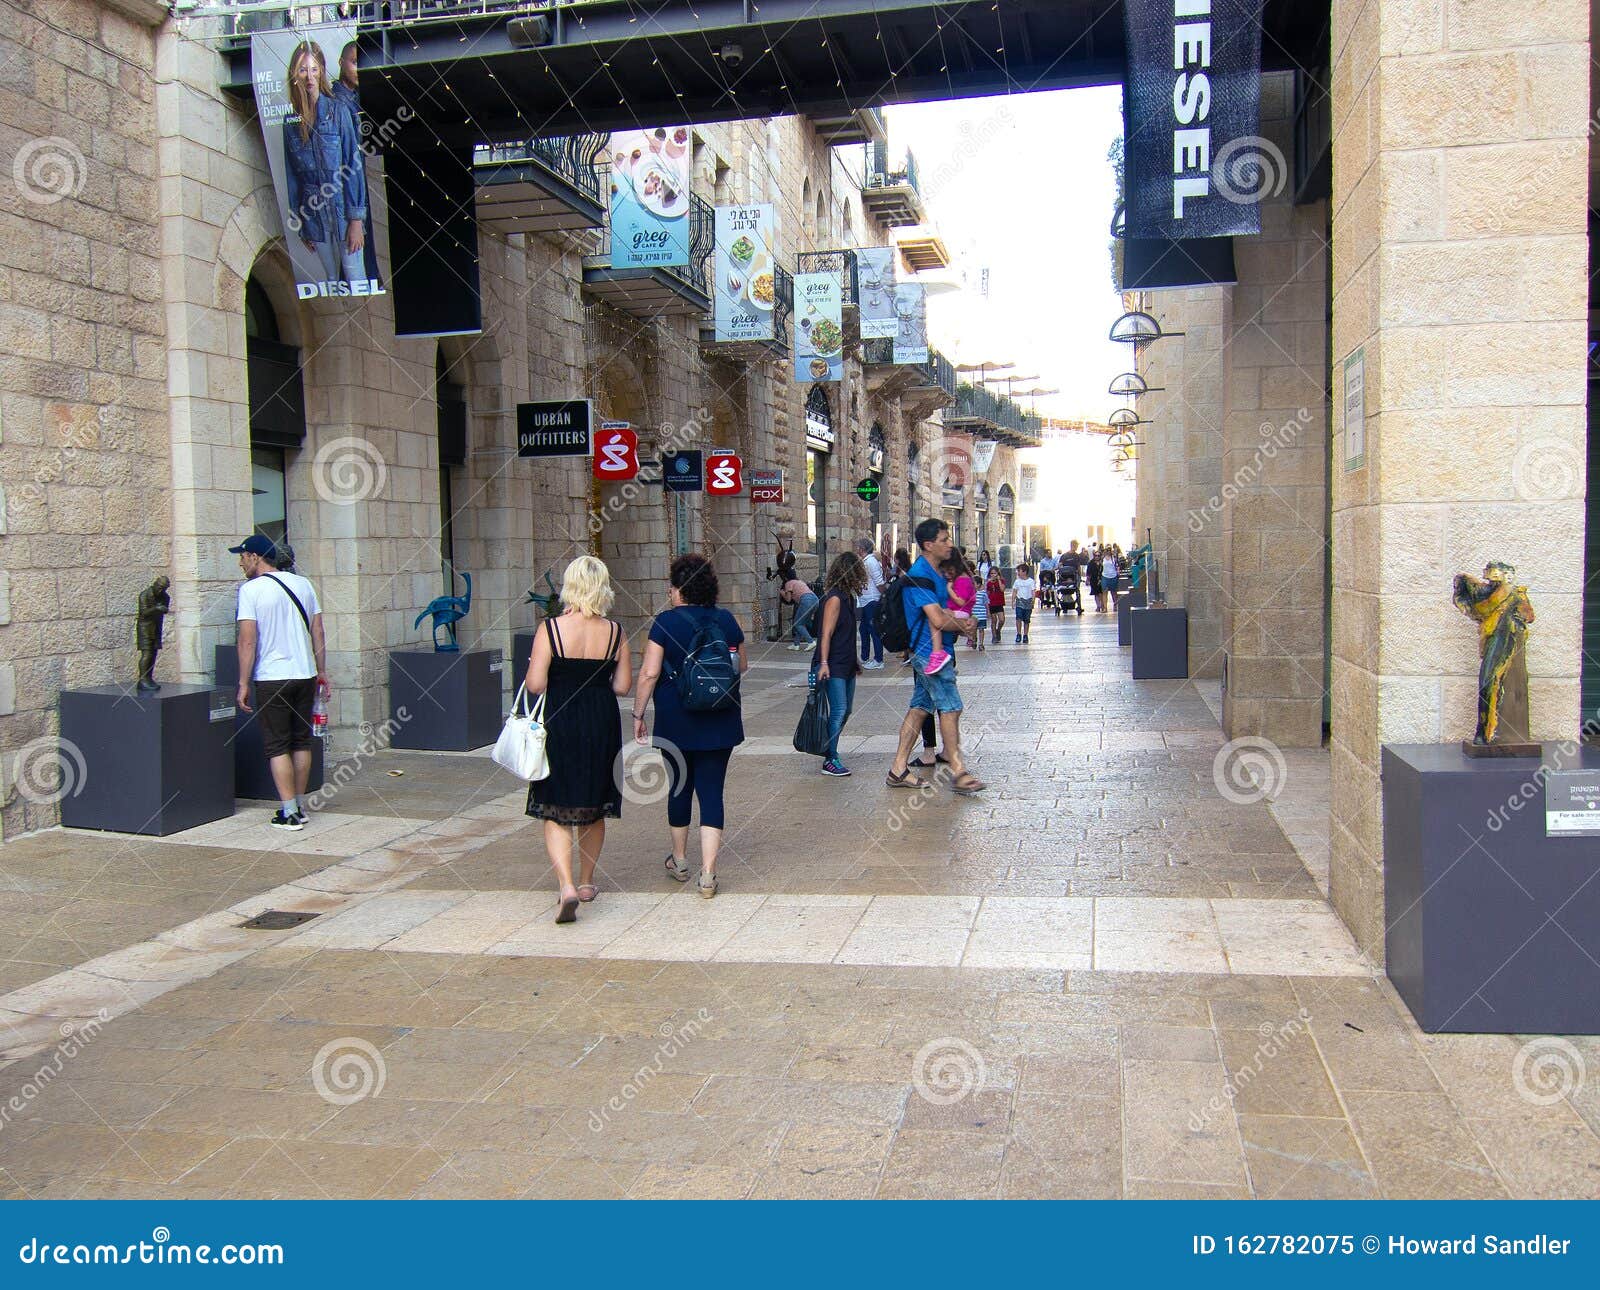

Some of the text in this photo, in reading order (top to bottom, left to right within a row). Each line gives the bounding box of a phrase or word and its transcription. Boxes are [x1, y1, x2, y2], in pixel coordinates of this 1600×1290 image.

[256, 71, 272, 83] WE
[258, 81, 282, 95] RULE
[261, 94, 272, 106] IN
[263, 104, 294, 118] DENIM
[633, 229, 671, 249] greg
[296, 279, 386, 299] DIESEL
[731, 313, 760, 329] greg
[534, 412, 571, 427] URBAN
[520, 431, 587, 447] OUTFITTERS
[753, 489, 780, 499] FOX
